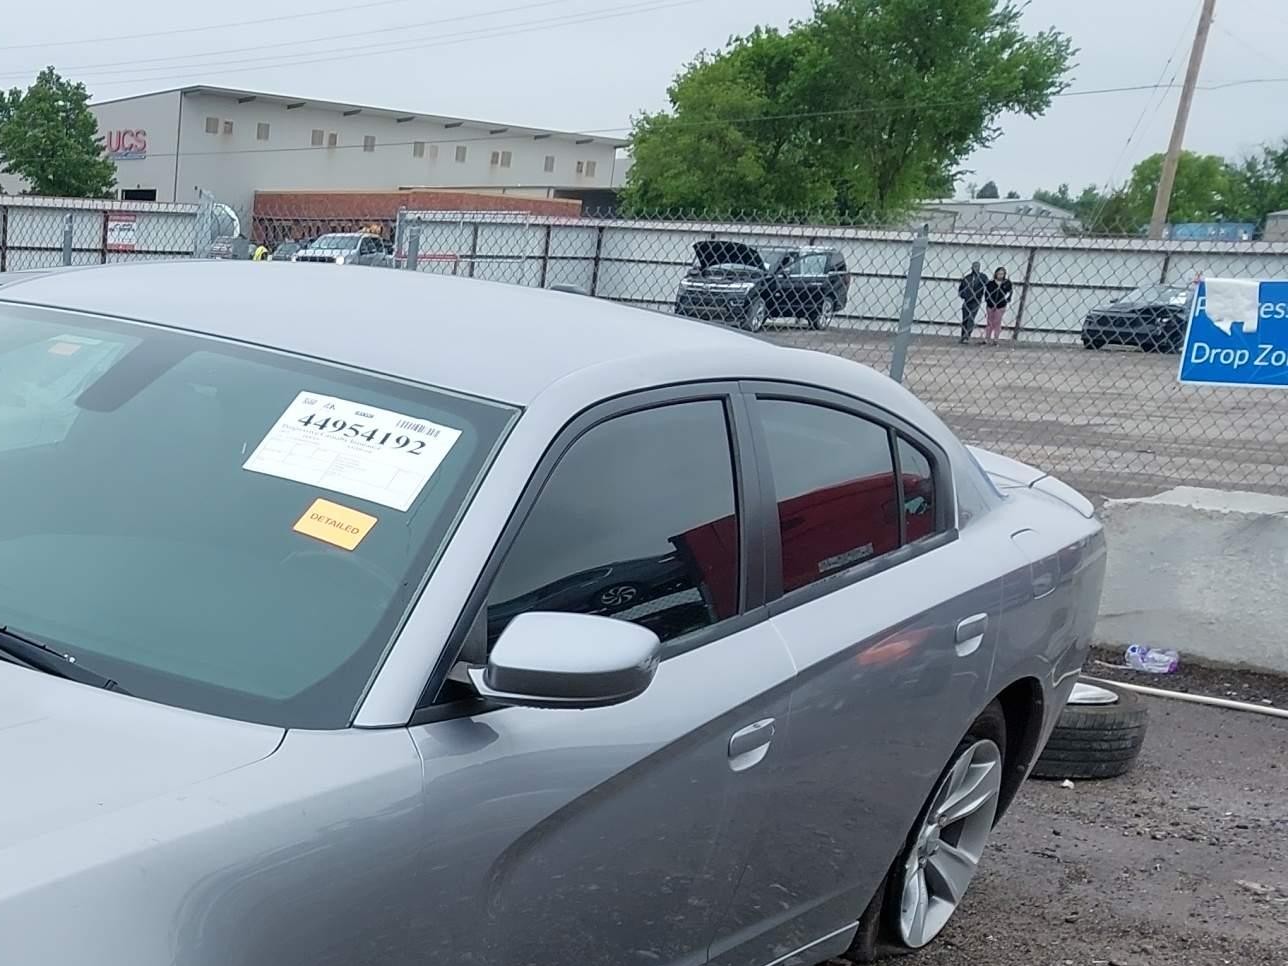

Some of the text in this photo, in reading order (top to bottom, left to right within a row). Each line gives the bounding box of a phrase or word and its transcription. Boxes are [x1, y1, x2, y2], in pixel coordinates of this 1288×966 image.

[107, 129, 146, 152] UCS
[1191, 342, 1288, 369] Drop Zo
[297, 413, 426, 455] 44954192
[310, 512, 360, 535] DETAILED
